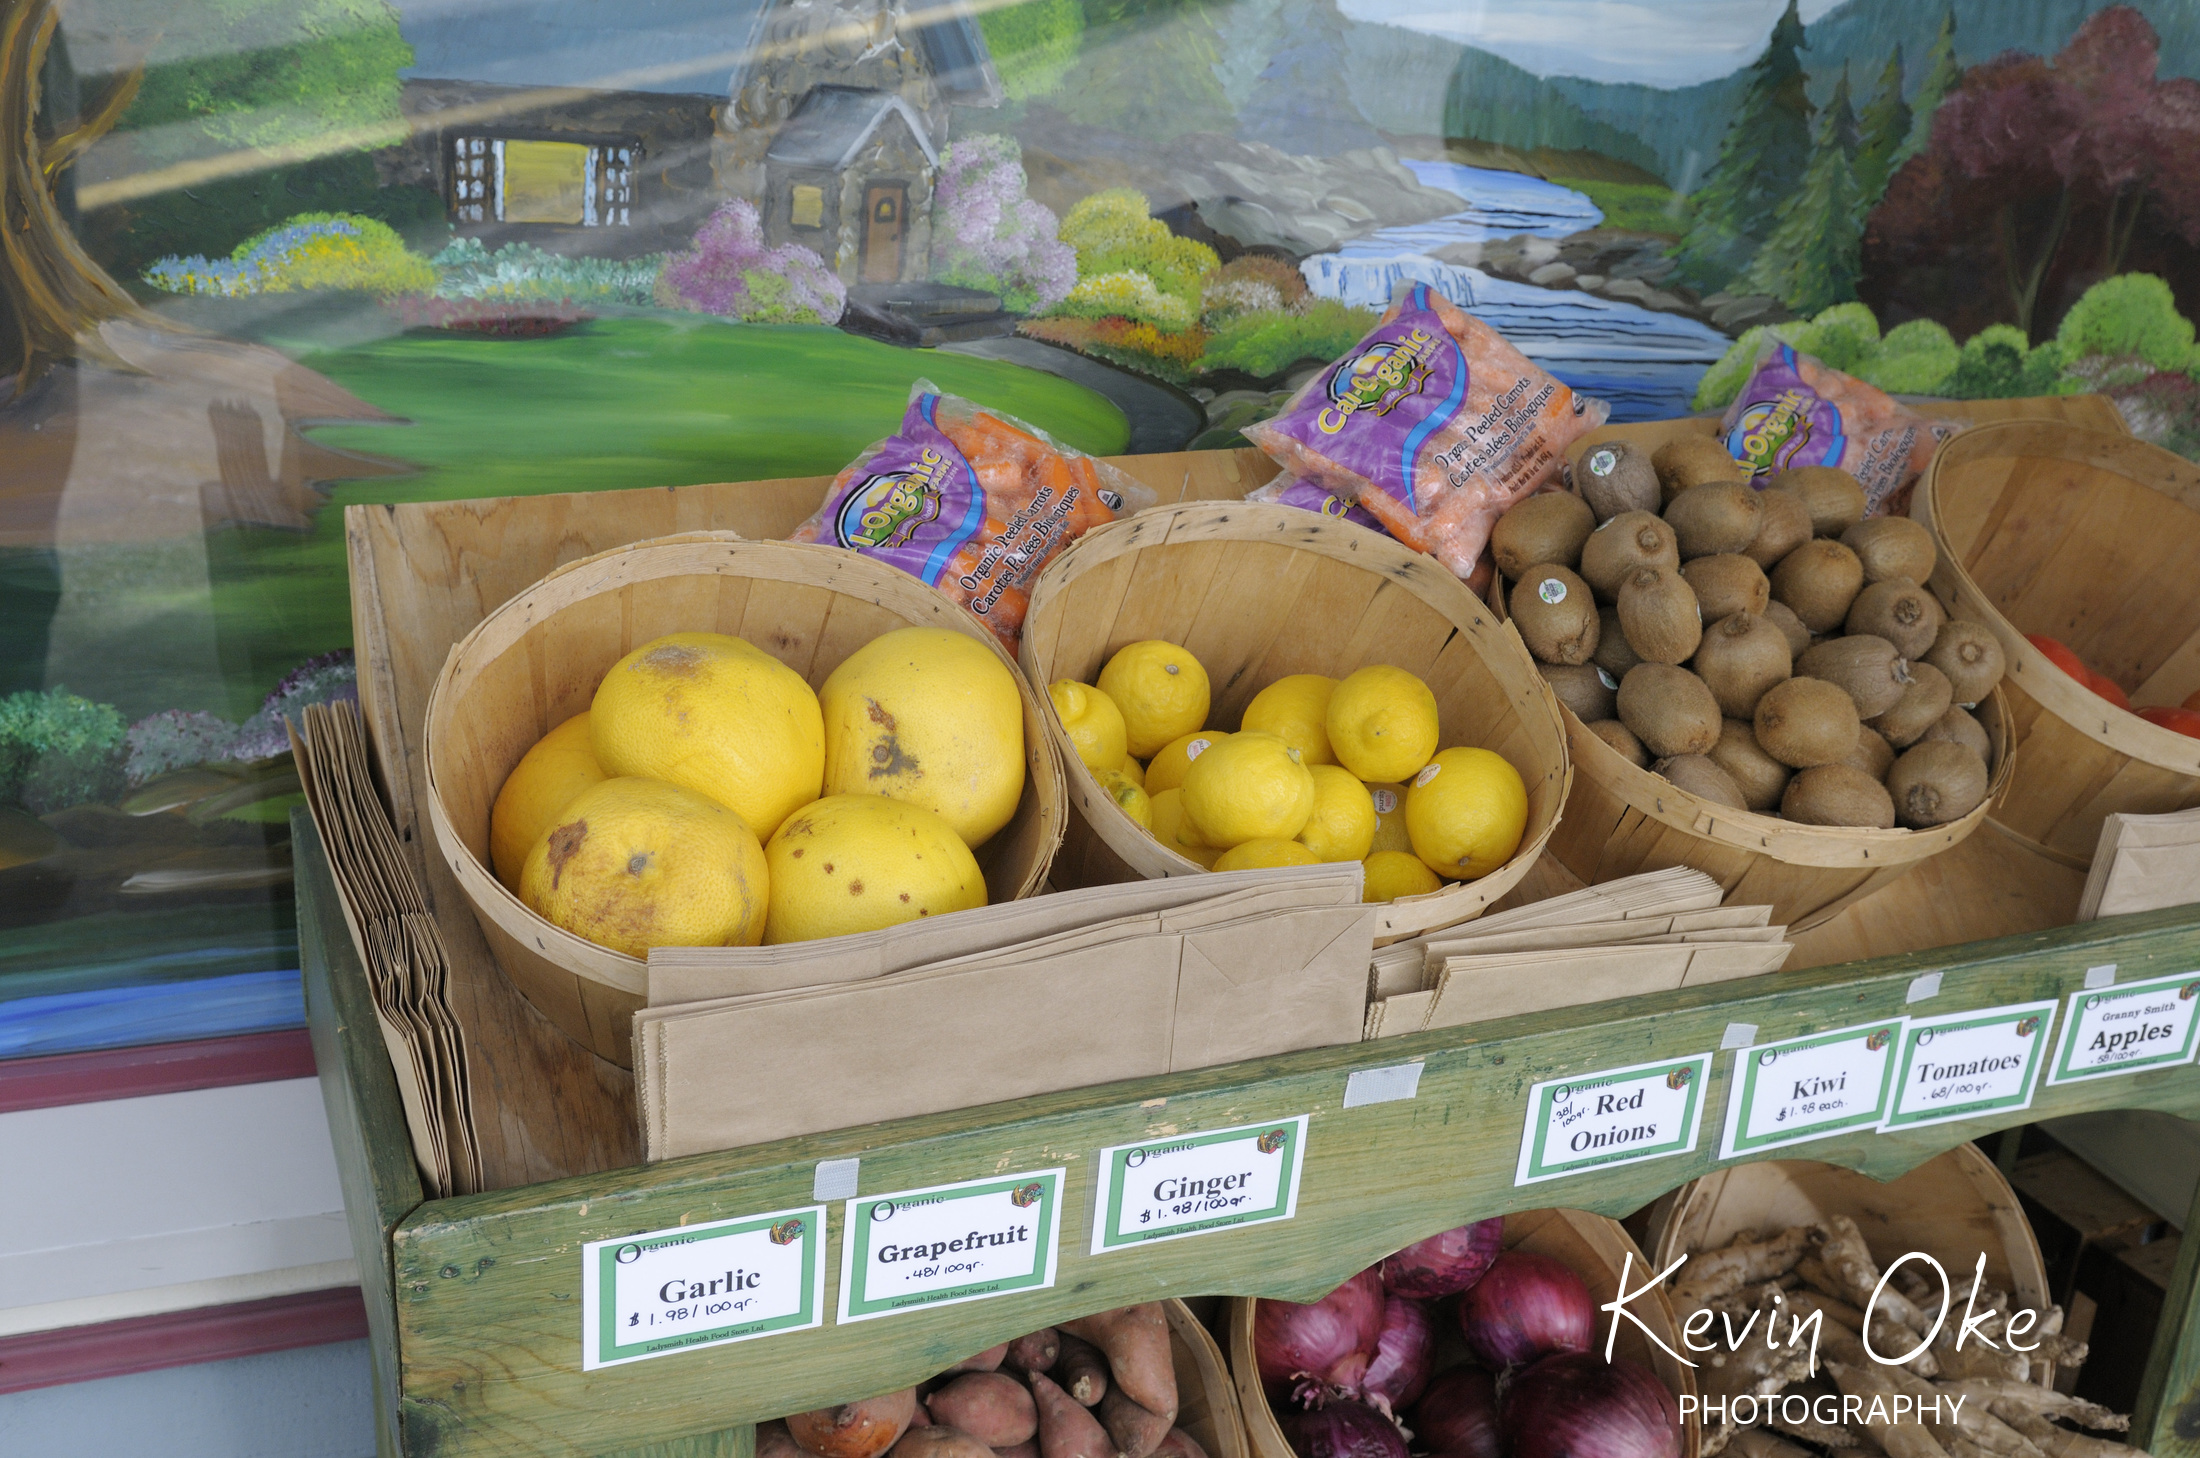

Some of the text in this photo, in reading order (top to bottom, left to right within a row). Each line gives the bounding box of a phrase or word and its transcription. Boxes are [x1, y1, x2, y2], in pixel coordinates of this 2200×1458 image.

[1318, 329, 1432, 434] Cal-Oganic
[1463, 405, 1501, 443] Peeled
[1496, 376, 1531, 411] Carrots
[1484, 434, 1511, 458] elées
[1503, 382, 1556, 434] Biologiques
[848, 448, 942, 553] l-Organic
[960, 546, 1003, 591] Organic
[993, 509, 1028, 550] Peeled
[2085, 990, 2136, 1011] Organic
[2102, 1001, 2176, 1022] Granny Smith
[1916, 1025, 1971, 1047] Organic
[2089, 1023, 2173, 1053] Apples
[1759, 1043, 1816, 1067] Organic
[1917, 1053, 2021, 1084] Tomatoes
[1552, 1078, 1614, 1104] Organic
[1791, 1071, 1847, 1101] Kiwi
[1594, 1088, 1645, 1116] Red
[1570, 1123, 1657, 1152] Onions
[1125, 1142, 1195, 1168] Organic
[1153, 1171, 1252, 1202] Ginger
[870, 1195, 945, 1222] Organic
[1143, 1228, 1175, 1240] Ladysmith
[1176, 1224, 1197, 1234] Health
[1199, 1221, 1215, 1231] Food
[1216, 1218, 1232, 1228] Store
[615, 1236, 695, 1264] Organic
[878, 1225, 1028, 1263] Grapefruit
[659, 1268, 761, 1303] Garlic
[891, 1296, 926, 1308] Ladysmith
[926, 1292, 949, 1302] Health
[950, 1288, 968, 1298] Food
[968, 1286, 986, 1296] Store
[646, 1340, 684, 1352] Ladysmith
[685, 1334, 709, 1345] Health
[711, 1330, 730, 1340] Food
[731, 1327, 750, 1337] Store
